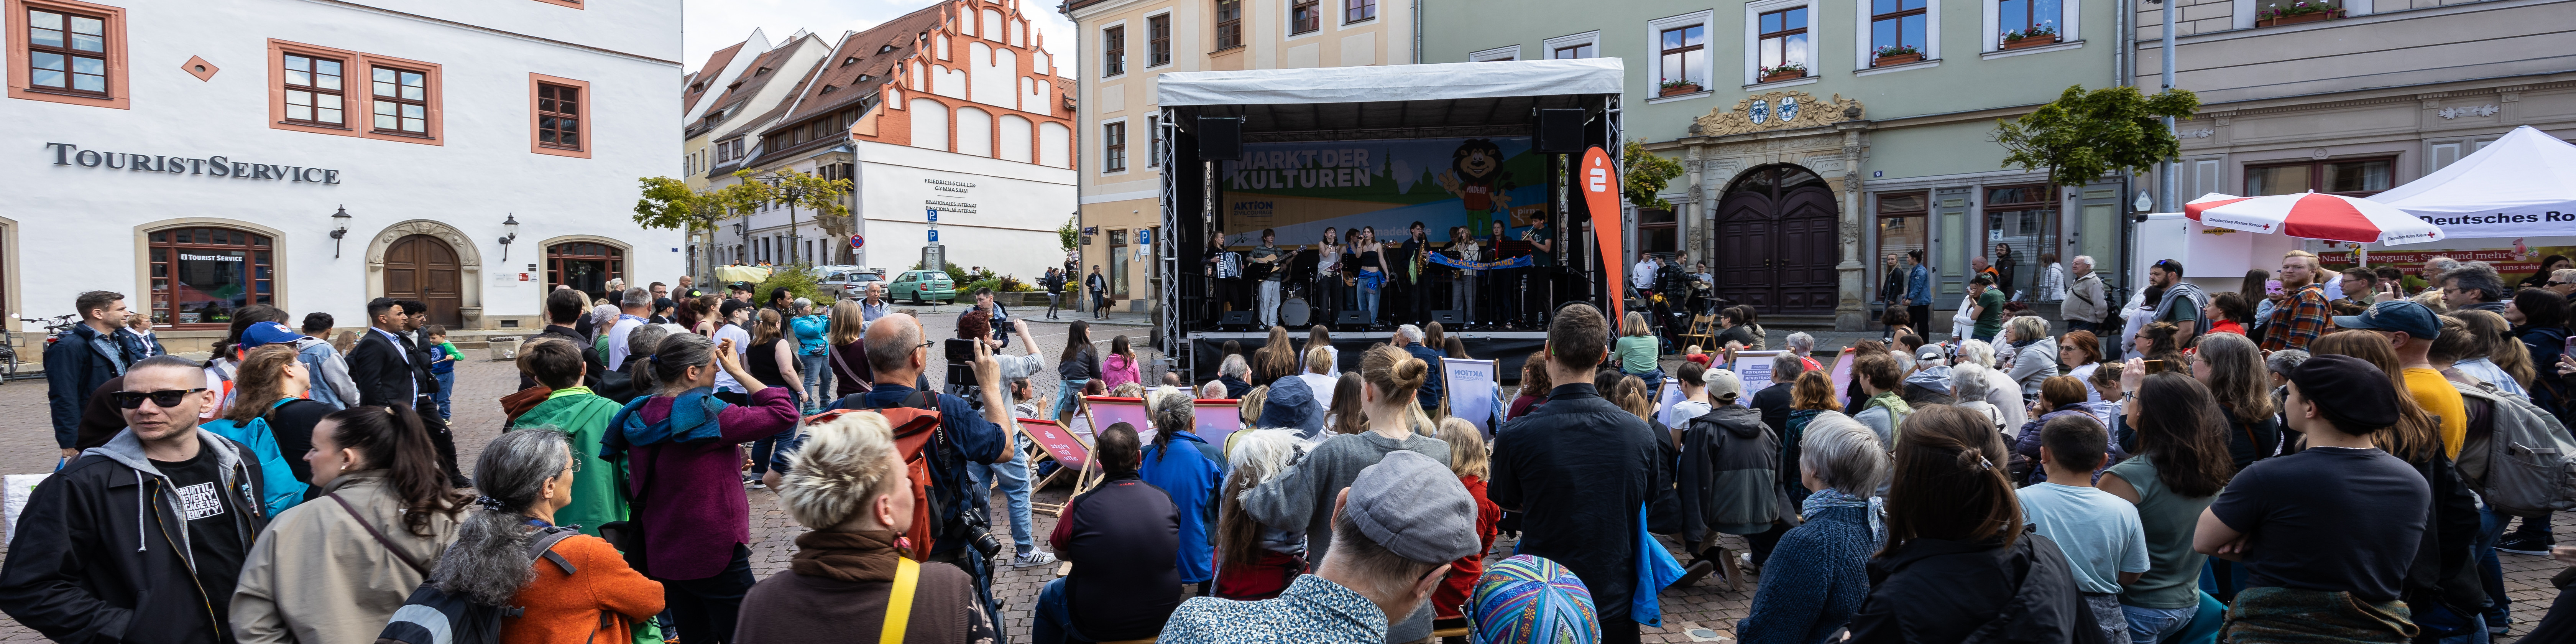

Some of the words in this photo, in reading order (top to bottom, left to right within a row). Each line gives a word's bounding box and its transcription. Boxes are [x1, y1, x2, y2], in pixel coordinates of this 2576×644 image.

[1233, 150, 1318, 170] MARKT
[1322, 149, 1370, 168] DER
[925, 178, 977, 188] FRIEDRICH-SCHILLER-
[1233, 168, 1371, 189] KULTUREN
[1466, 186, 1486, 194] MADEKU
[929, 211, 935, 219] P
[1518, 208, 1540, 219] pirn
[930, 231, 936, 240] P
[1142, 232, 1148, 242] P
[2361, 255, 2417, 263] ewegung,
[182, 491, 214, 504] EVERY
[187, 505, 219, 519] EMPTY
